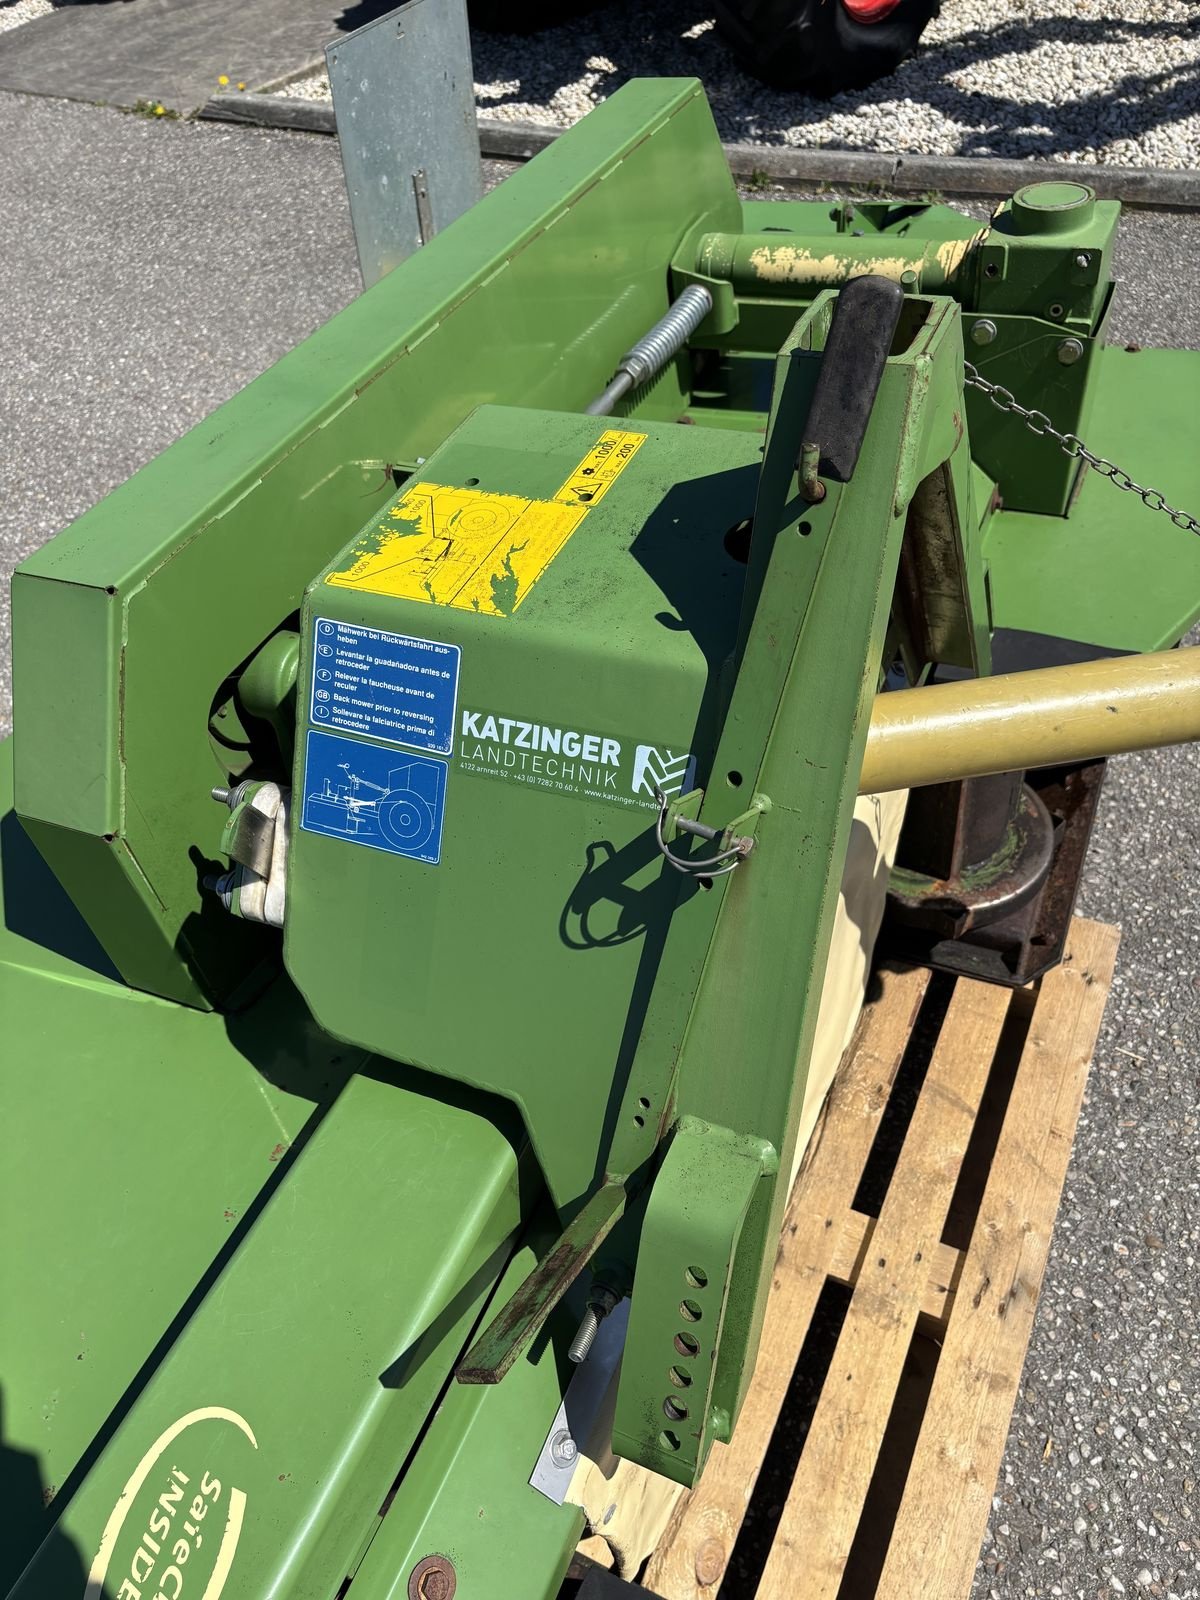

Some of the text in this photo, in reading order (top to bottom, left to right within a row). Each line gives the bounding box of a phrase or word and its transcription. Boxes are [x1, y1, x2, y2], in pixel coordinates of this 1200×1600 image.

[616, 443, 635, 459] 200
[336, 634, 358, 645] heben
[337, 625, 368, 638] Mähwerk
[369, 632, 380, 640] bei
[381, 634, 434, 651] Rückwärtsfahrt
[434, 646, 450, 655] aus-
[335, 658, 370, 671] retroceder
[336, 648, 365, 660] Levantar
[366, 655, 373, 663] la
[374, 658, 419, 673] guadañadora
[420, 667, 440, 677] antes
[441, 671, 450, 679] de
[334, 681, 357, 691] reculer
[335, 670, 360, 682] Relever
[361, 676, 367, 685] la
[369, 678, 404, 693] faucheuse
[405, 688, 424, 697] avant
[425, 691, 435, 700] de
[317, 691, 434, 724] GB Back mower prior to reversing
[332, 706, 364, 720] Sollevare
[364, 714, 371, 722] la
[372, 716, 405, 730] falciatrice
[406, 725, 427, 735] prima
[427, 729, 435, 737] di
[331, 717, 370, 731] retrocedere
[462, 711, 621, 767] KATZINGER
[460, 741, 617, 789] LANDTECHNIK
[459, 762, 476, 771] 4122
[476, 766, 499, 776] arnreit
[500, 770, 508, 778] 52
[513, 773, 526, 781] +43
[526, 775, 536, 784] (0)
[537, 777, 553, 787] 7282
[555, 781, 563, 790] 70
[564, 783, 573, 792] 60
[584, 789, 662, 810] www.katzinger-landte
[117, 1465, 191, 1600] INSIDE
